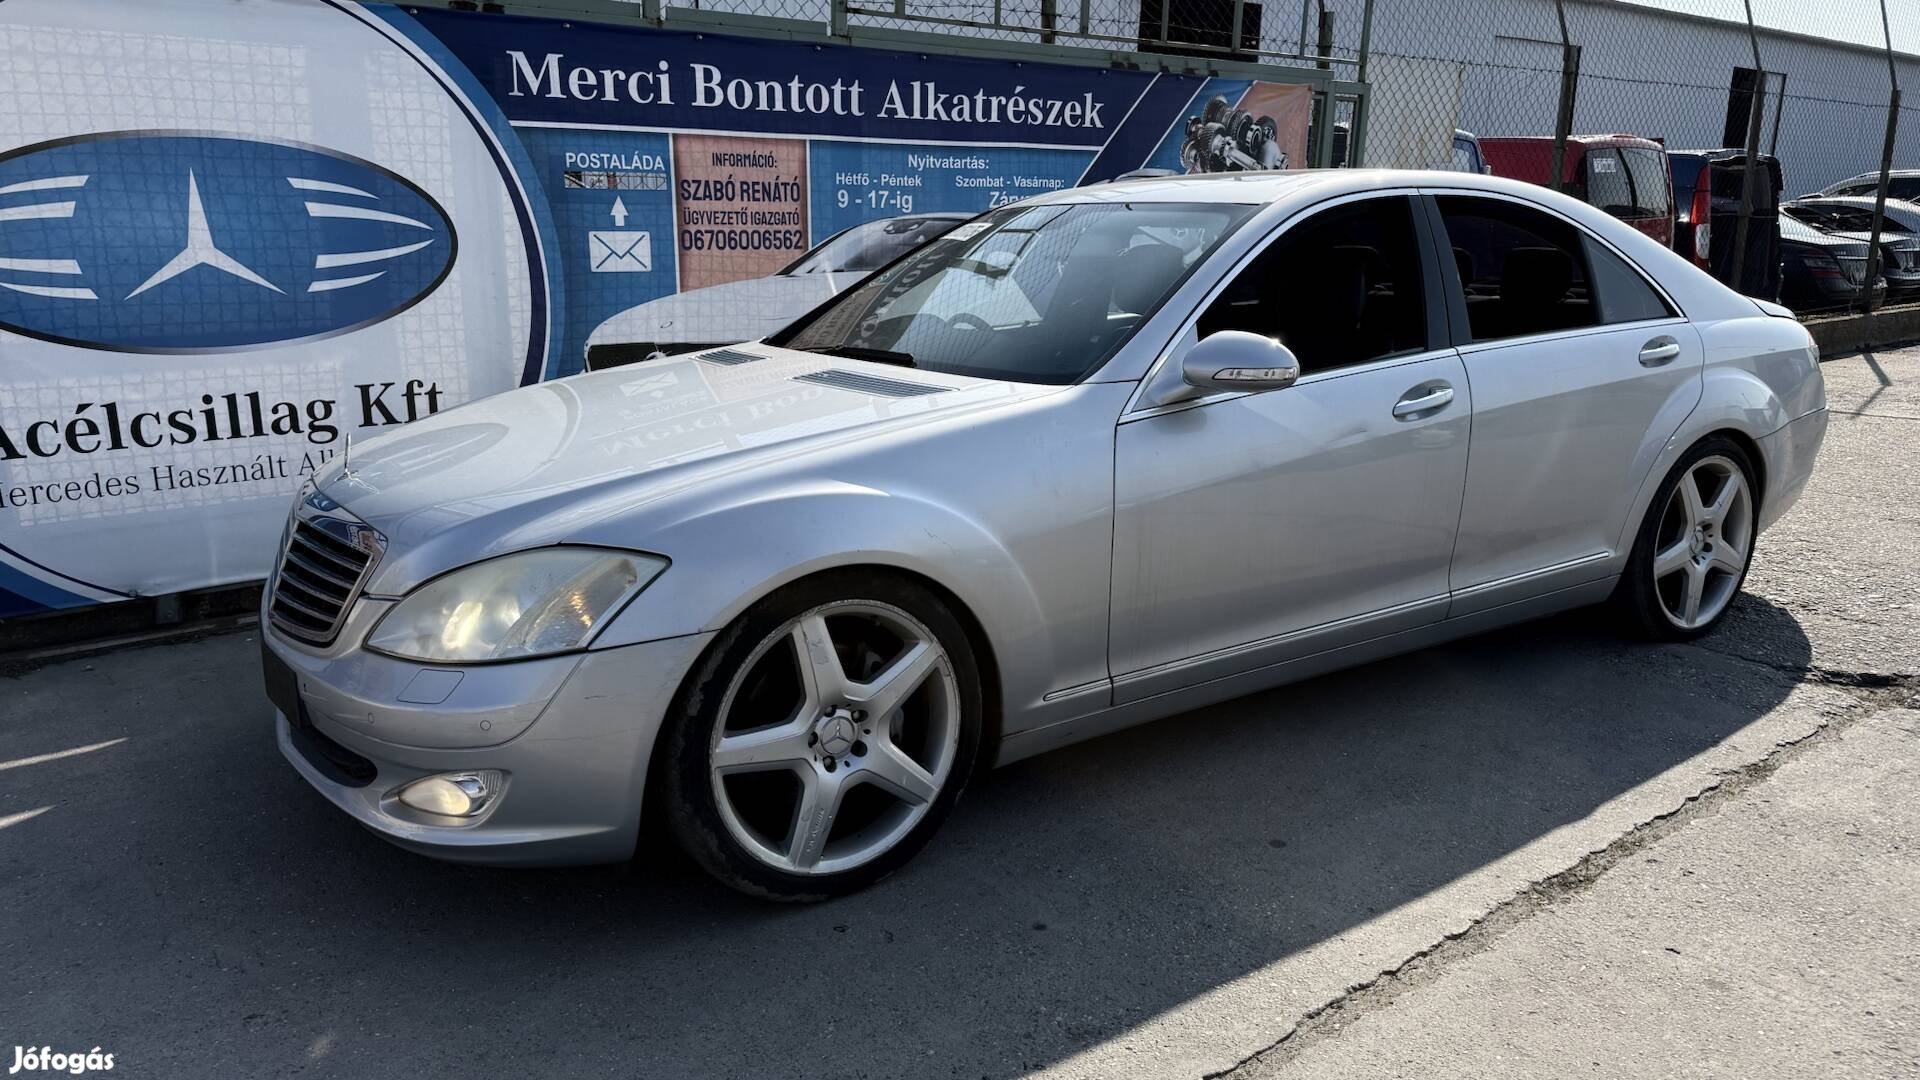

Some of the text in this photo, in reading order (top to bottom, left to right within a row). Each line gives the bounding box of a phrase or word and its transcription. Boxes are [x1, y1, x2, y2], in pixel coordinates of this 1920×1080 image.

[506, 50, 1105, 129] Merci Bontott Alkatrészek
[565, 151, 665, 171] POSTALÁDA
[712, 151, 778, 169] INFORMÁCIÓ:
[908, 154, 989, 172] Nyitvatartás:
[681, 174, 800, 203] SZABÓ RENÁTÓ
[881, 174, 922, 187] Péntek
[956, 175, 1003, 188] Szombat
[1013, 176, 1065, 191] Vasárnap:
[837, 189, 849, 208] 9
[867, 190, 913, 213] 17-ig
[683, 206, 800, 226] ÜGYVEZETŐ IGAZGATÓ
[681, 229, 803, 251] 06706006562
[354, 379, 443, 427] Kft
[150, 453, 289, 491] Használt
